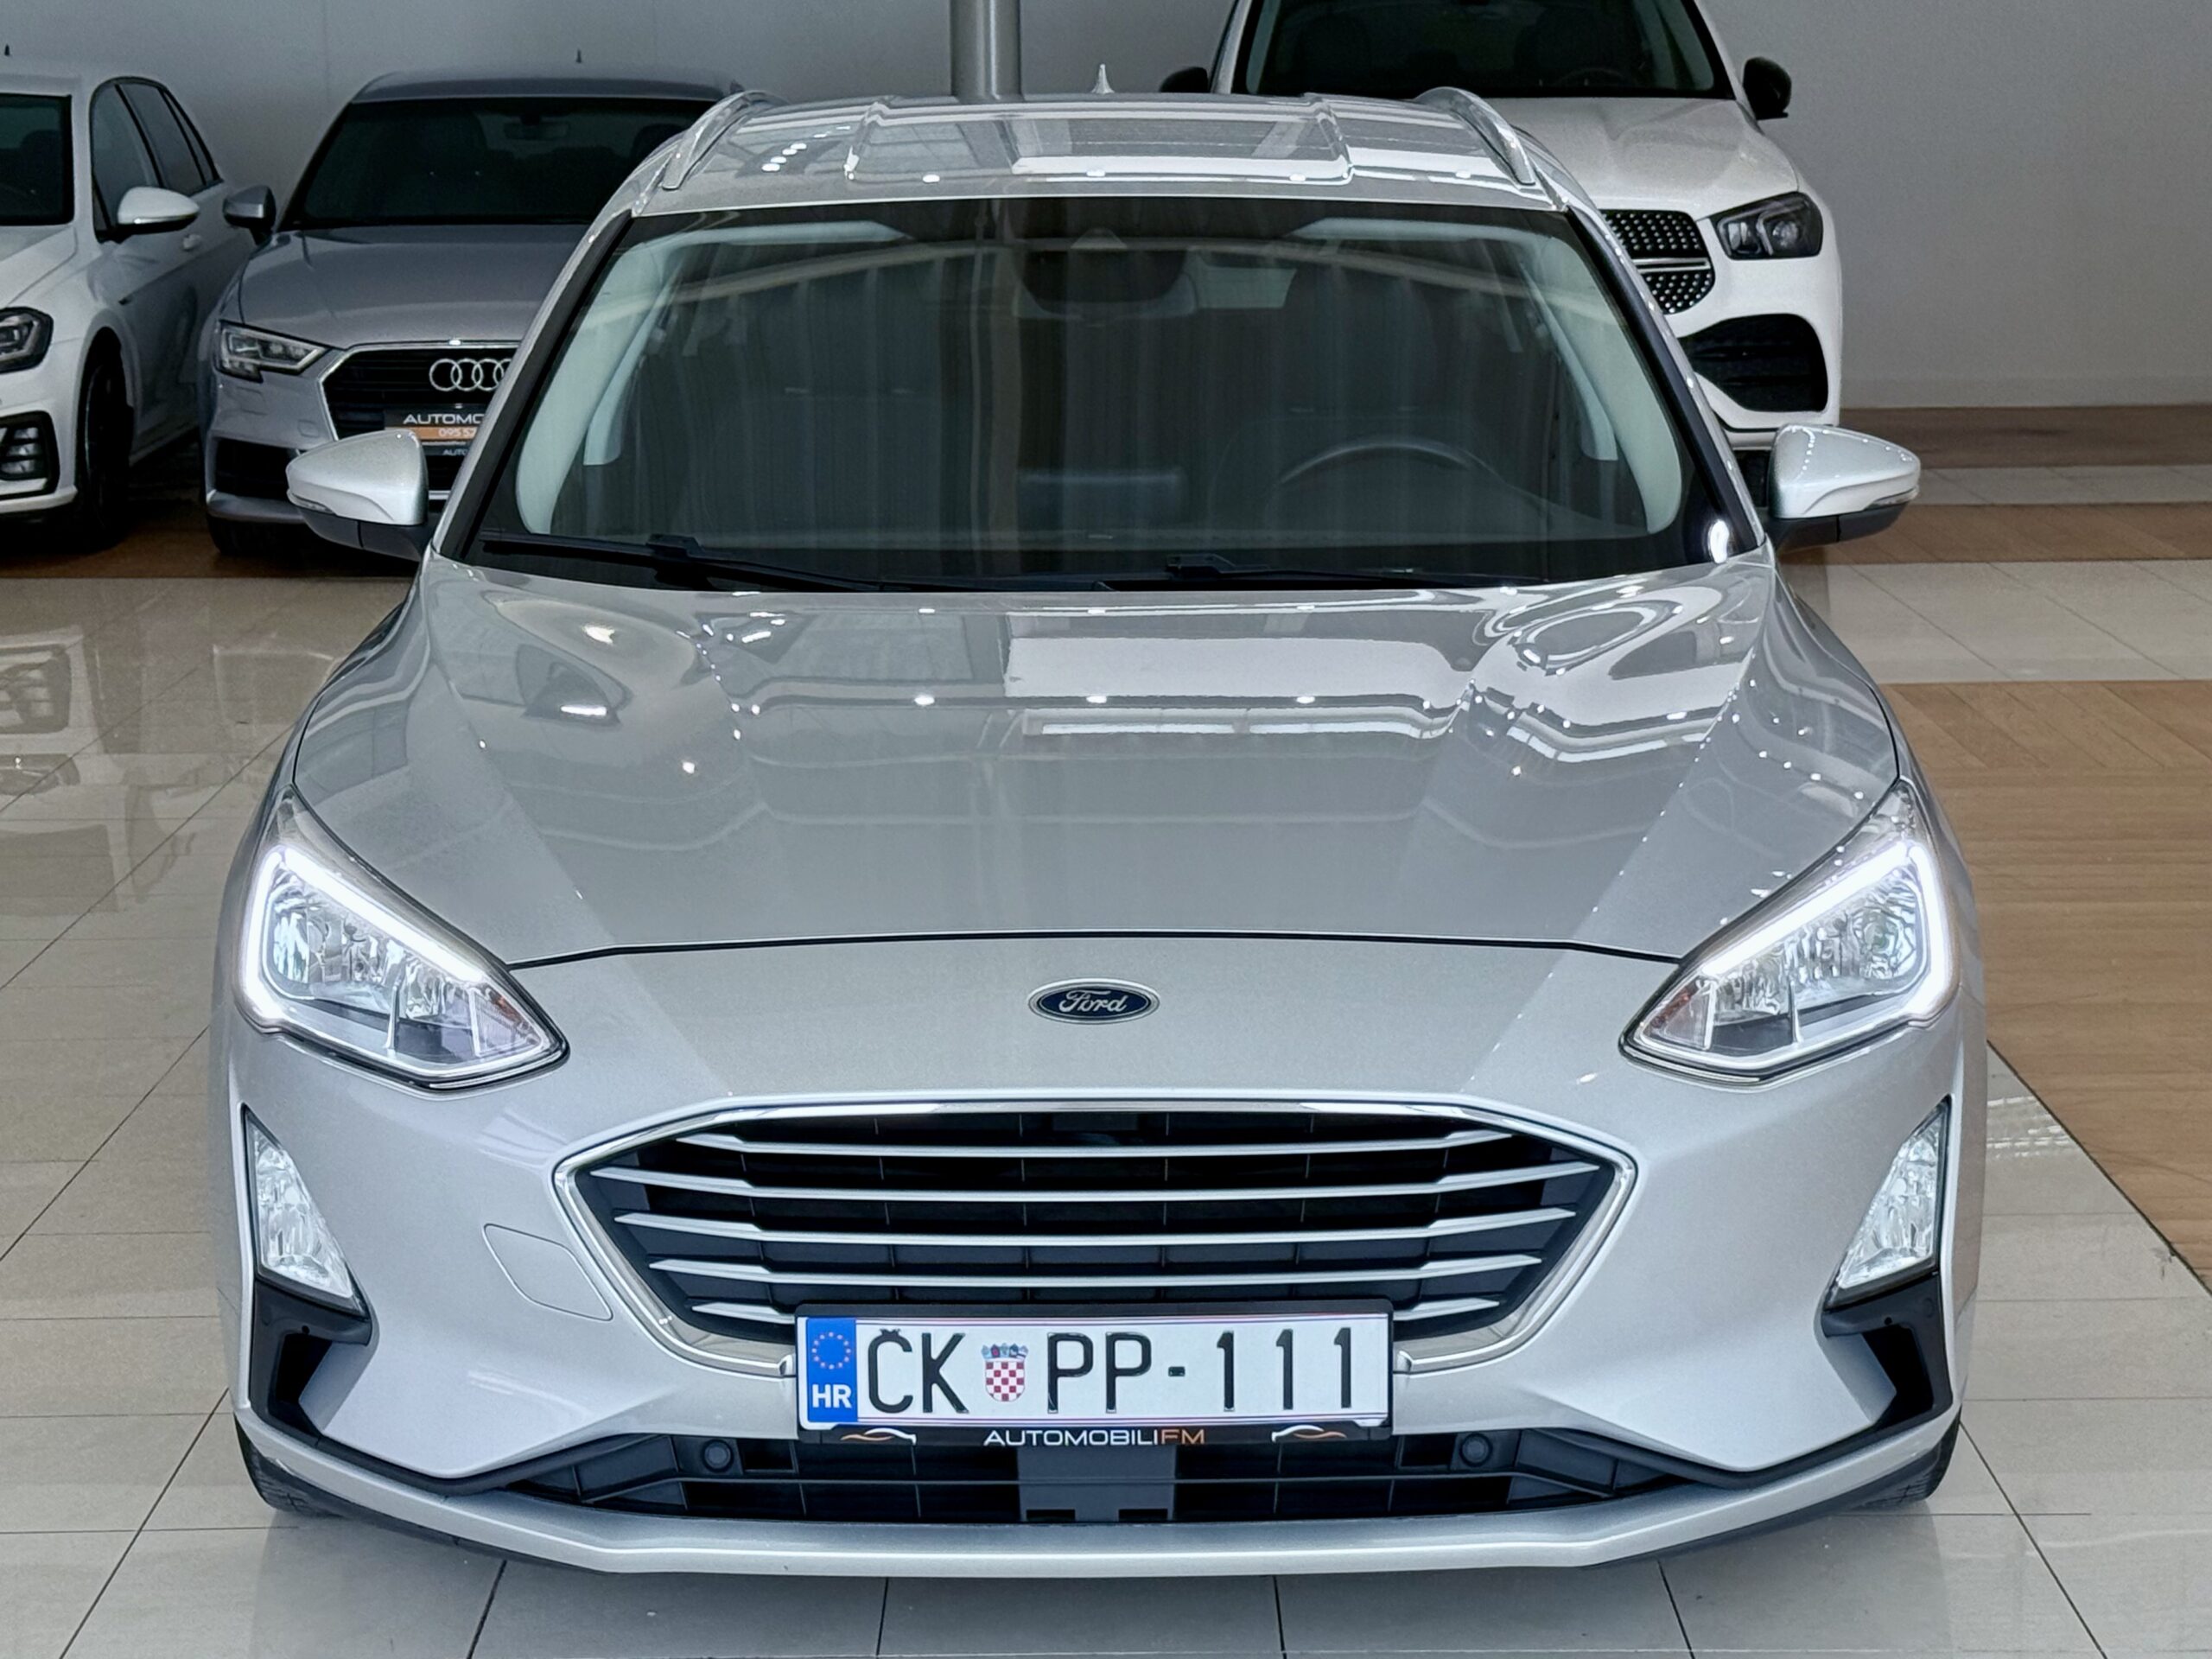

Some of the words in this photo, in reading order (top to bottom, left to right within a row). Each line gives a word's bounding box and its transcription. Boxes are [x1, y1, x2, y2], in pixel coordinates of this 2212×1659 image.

[1058, 989, 1128, 1013] Ford
[868, 1329, 969, 1414] ČK
[812, 1384, 852, 1408] HR
[983, 1428, 1205, 1446] AUTOMOBILIFM
